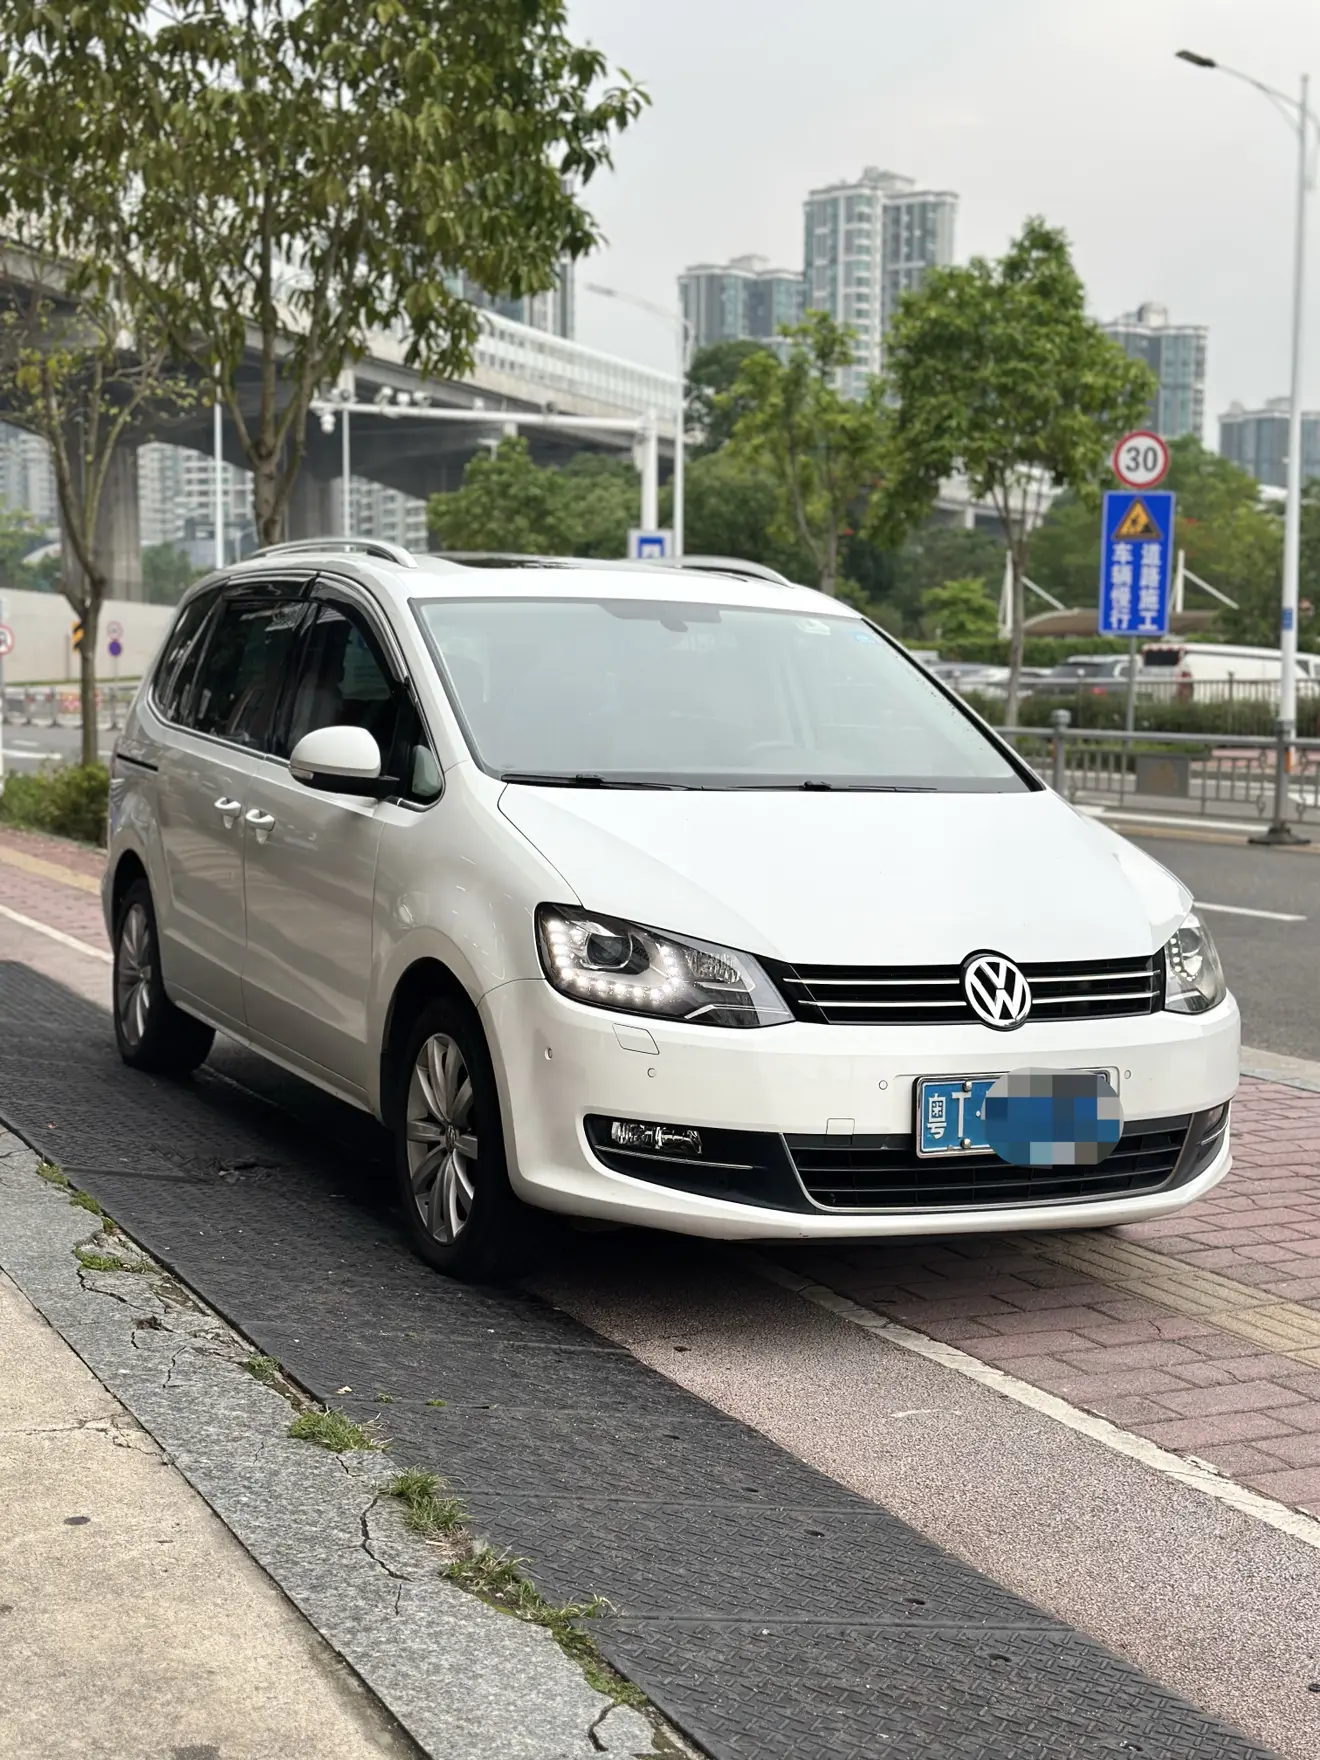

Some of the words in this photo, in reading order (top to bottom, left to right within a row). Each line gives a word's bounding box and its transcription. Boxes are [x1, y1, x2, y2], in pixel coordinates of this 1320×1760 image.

[1125, 446, 1158, 473] 30
[1109, 542, 1134, 630] 车辆慢行
[1137, 542, 1162, 631] 道路施工
[964, 956, 1032, 1028] VW
